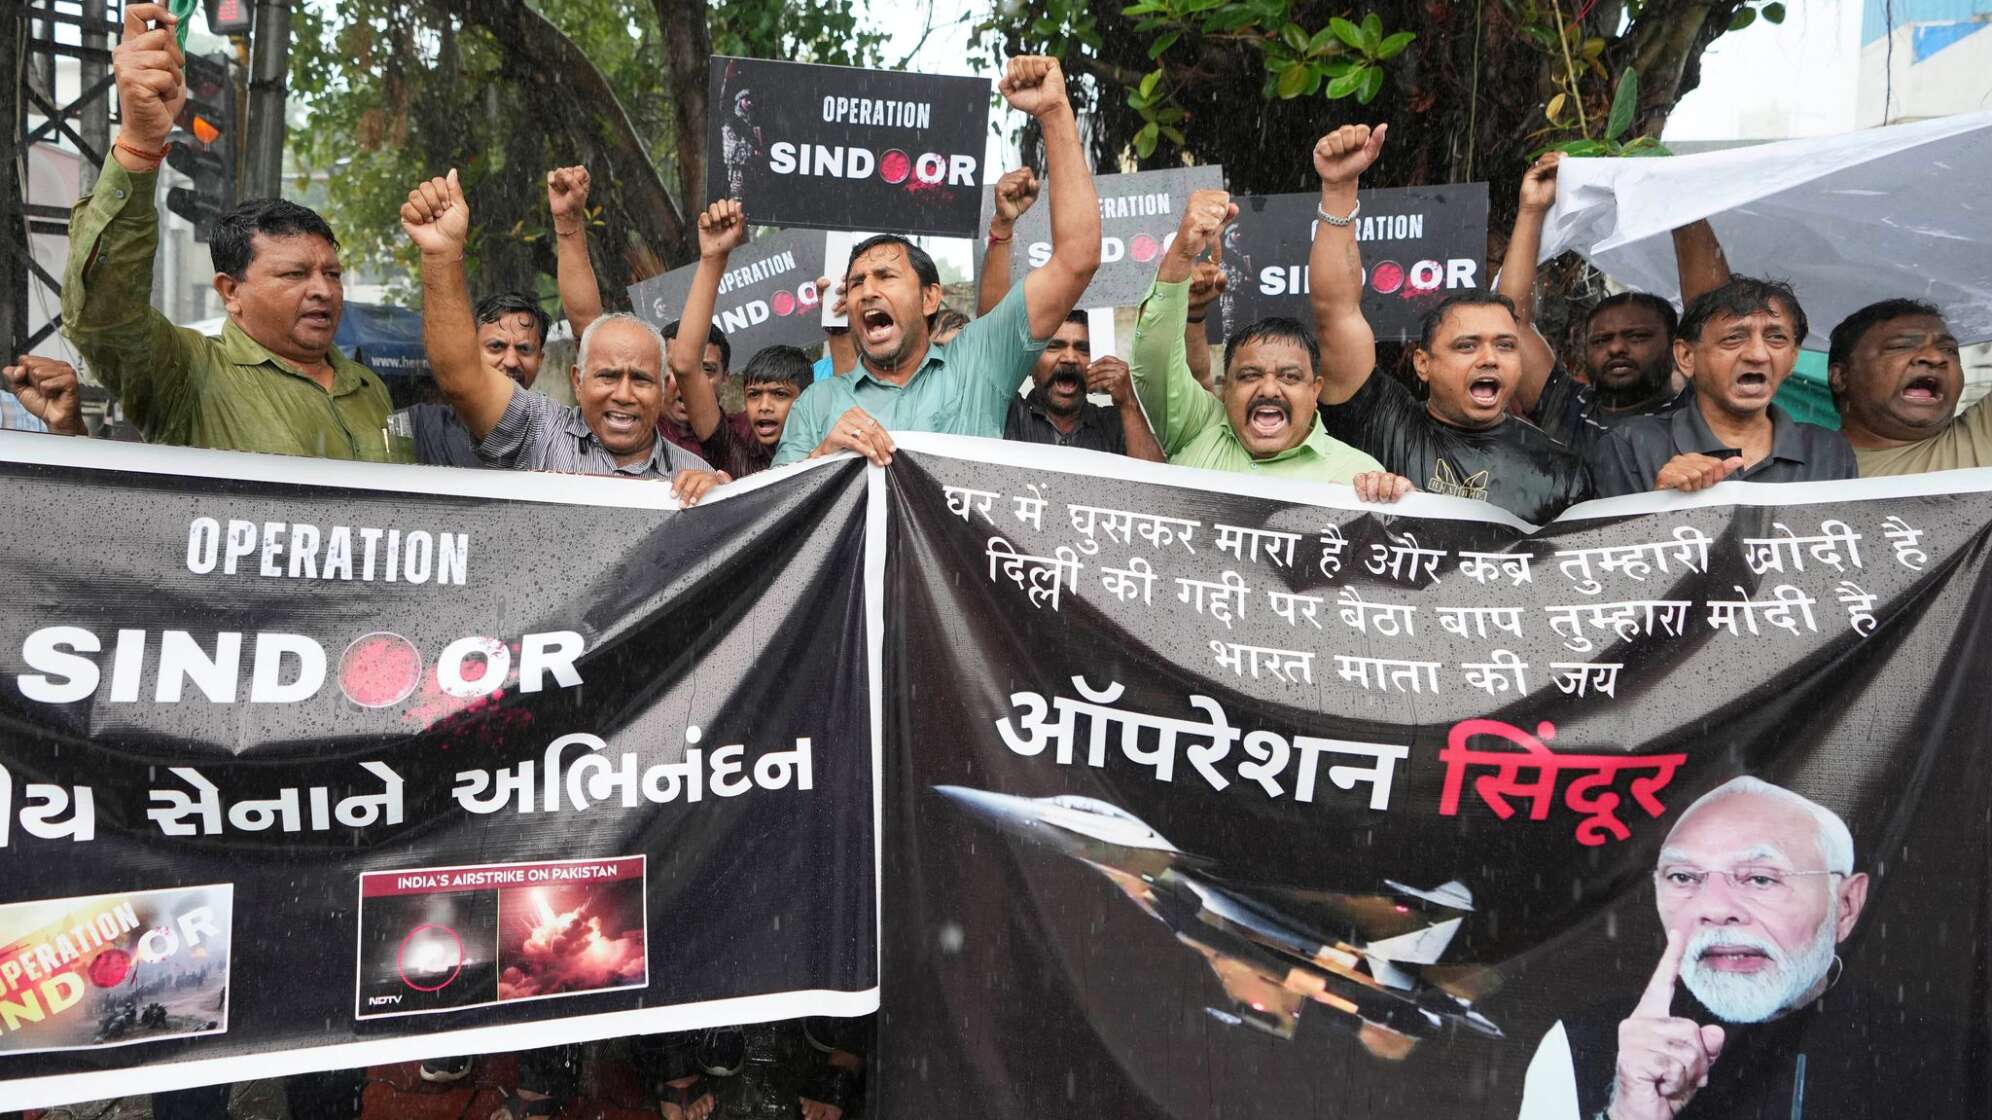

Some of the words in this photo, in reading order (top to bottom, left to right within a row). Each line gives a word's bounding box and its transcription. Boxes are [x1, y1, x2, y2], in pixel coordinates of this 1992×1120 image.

[823, 96, 931, 129] OPERATION
[1259, 257, 1478, 296] SIOOR
[187, 516, 469, 585] OPERATION
[942, 485, 999, 525] घर
[1013, 483, 1048, 531] में
[1067, 503, 1201, 555] घुसकर
[1214, 523, 1302, 567] मारा
[1319, 524, 1348, 579] है
[1364, 532, 1448, 584] और
[1459, 550, 1535, 587] कब्र
[1555, 526, 1713, 595] तुम्हारी
[1743, 519, 1862, 576] खोदी
[1881, 516, 1928, 570] है
[986, 537, 1083, 612] दिल्ली
[1101, 557, 1158, 606] की
[1177, 570, 1251, 630] गद्दी
[1269, 591, 1323, 630] पर
[1337, 585, 1416, 637] बैठा
[1436, 606, 1525, 639] बाप
[1545, 600, 1692, 653] तुम्हारा
[1706, 585, 1817, 638] मोदी
[1834, 581, 1878, 638] है
[1209, 640, 1315, 684] भारत
[1334, 654, 1441, 694] माता
[1461, 649, 1529, 697] की
[1550, 662, 1624, 698] जय
[146, 761, 405, 837] સેનાને
[451, 725, 813, 815] અભિનંદન
[995, 674, 1409, 811] ऑपरेशन
[1438, 718, 1688, 847] सिंदूर
[398, 873, 450, 889] INDIA'S
[452, 870, 525, 886] AIRSTRIKE
[528, 867, 549, 881] ON
[552, 864, 618, 880] PAKISTAN
[368, 994, 403, 1006] NDTV
